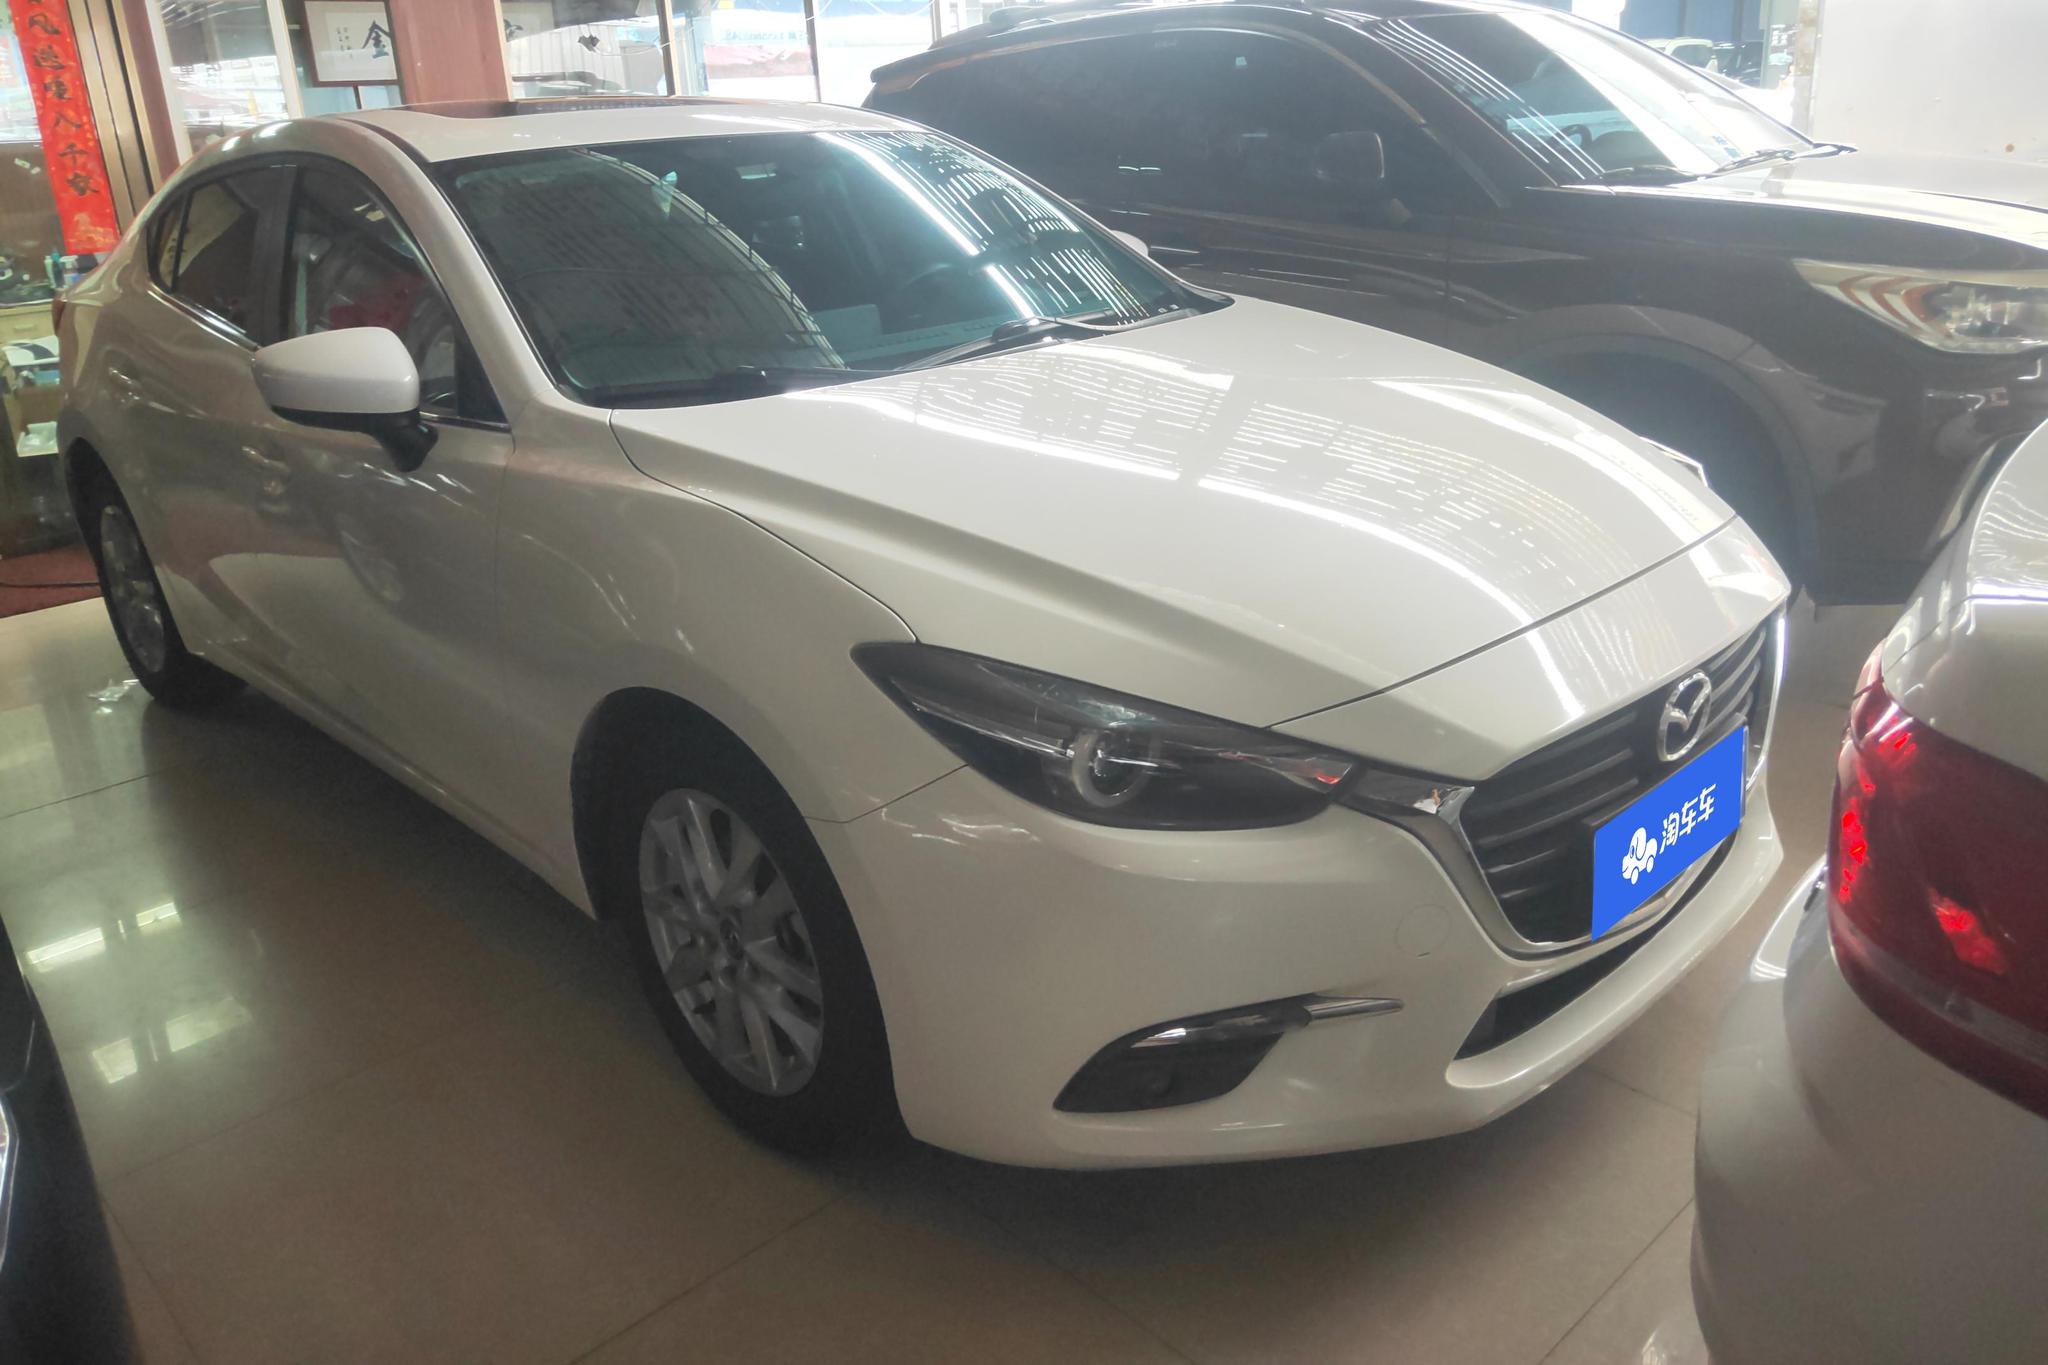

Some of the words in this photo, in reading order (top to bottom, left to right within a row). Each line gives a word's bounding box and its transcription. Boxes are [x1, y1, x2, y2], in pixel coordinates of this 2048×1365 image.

[27, 0, 99, 196] 风送暖入千家
